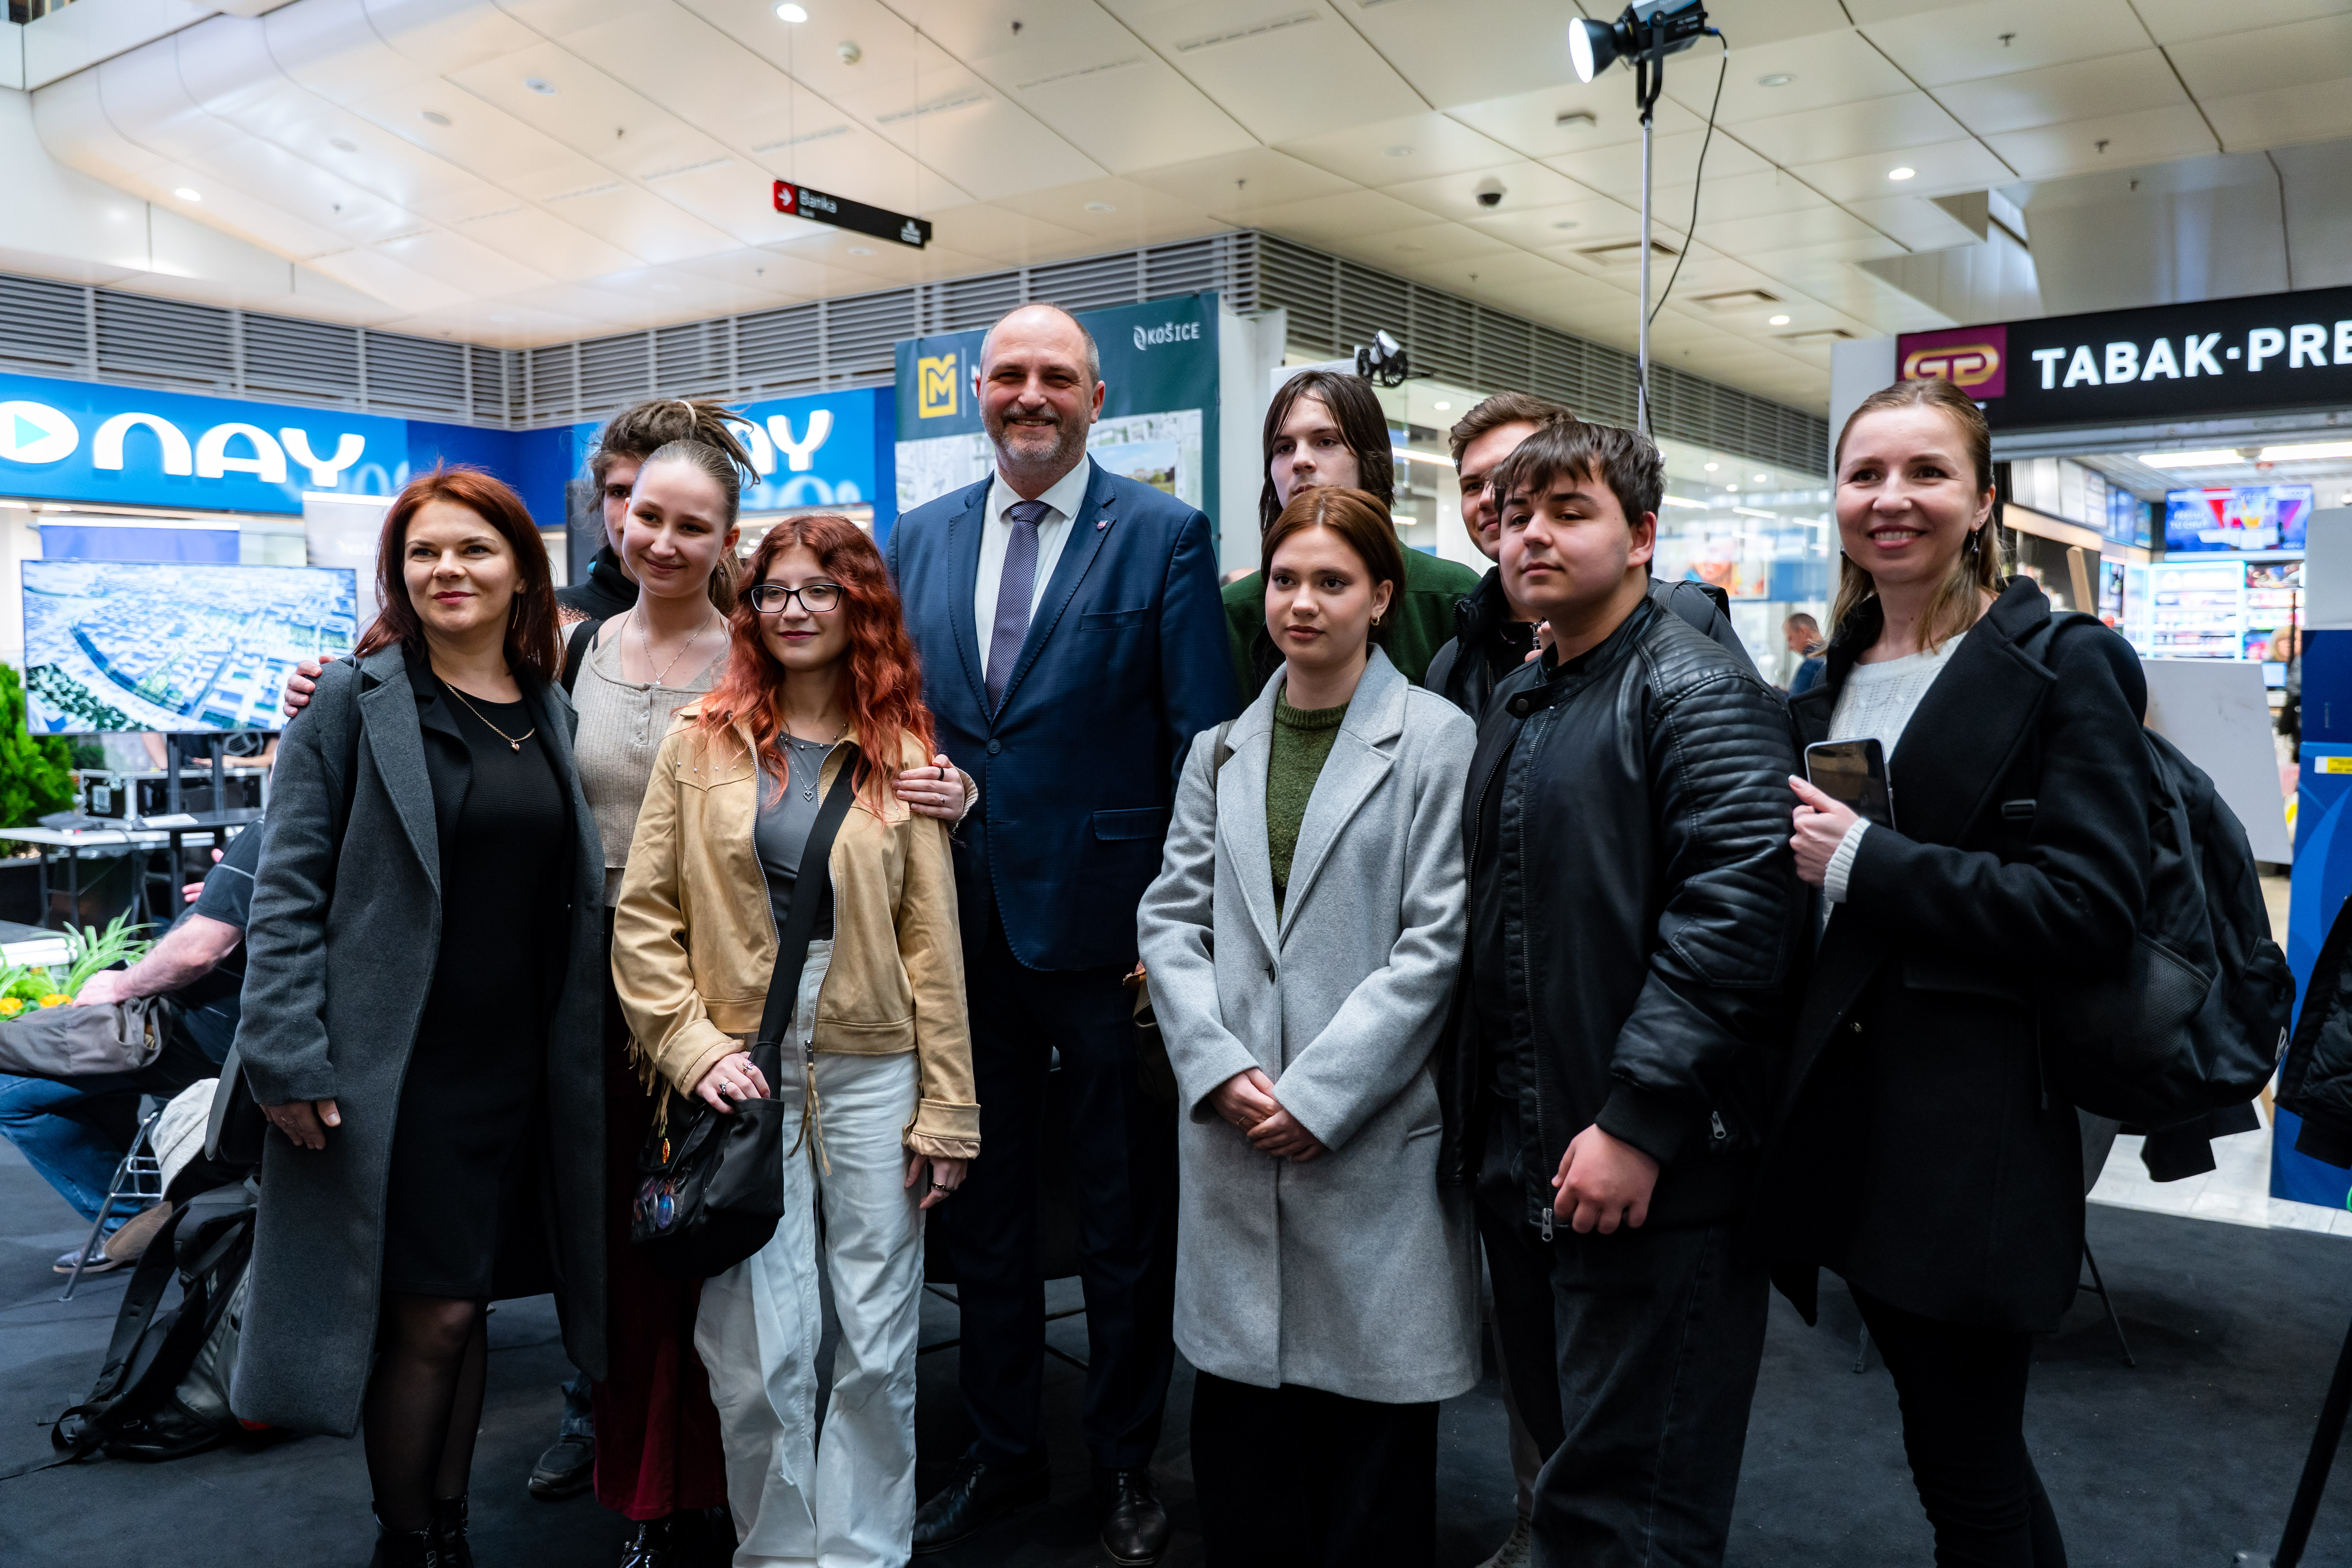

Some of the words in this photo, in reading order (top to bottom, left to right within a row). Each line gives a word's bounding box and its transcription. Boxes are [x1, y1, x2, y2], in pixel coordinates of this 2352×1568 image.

[799, 189, 837, 214] Banka
[1147, 321, 1200, 345] KOŠICE
[726, 409, 834, 475] AY
